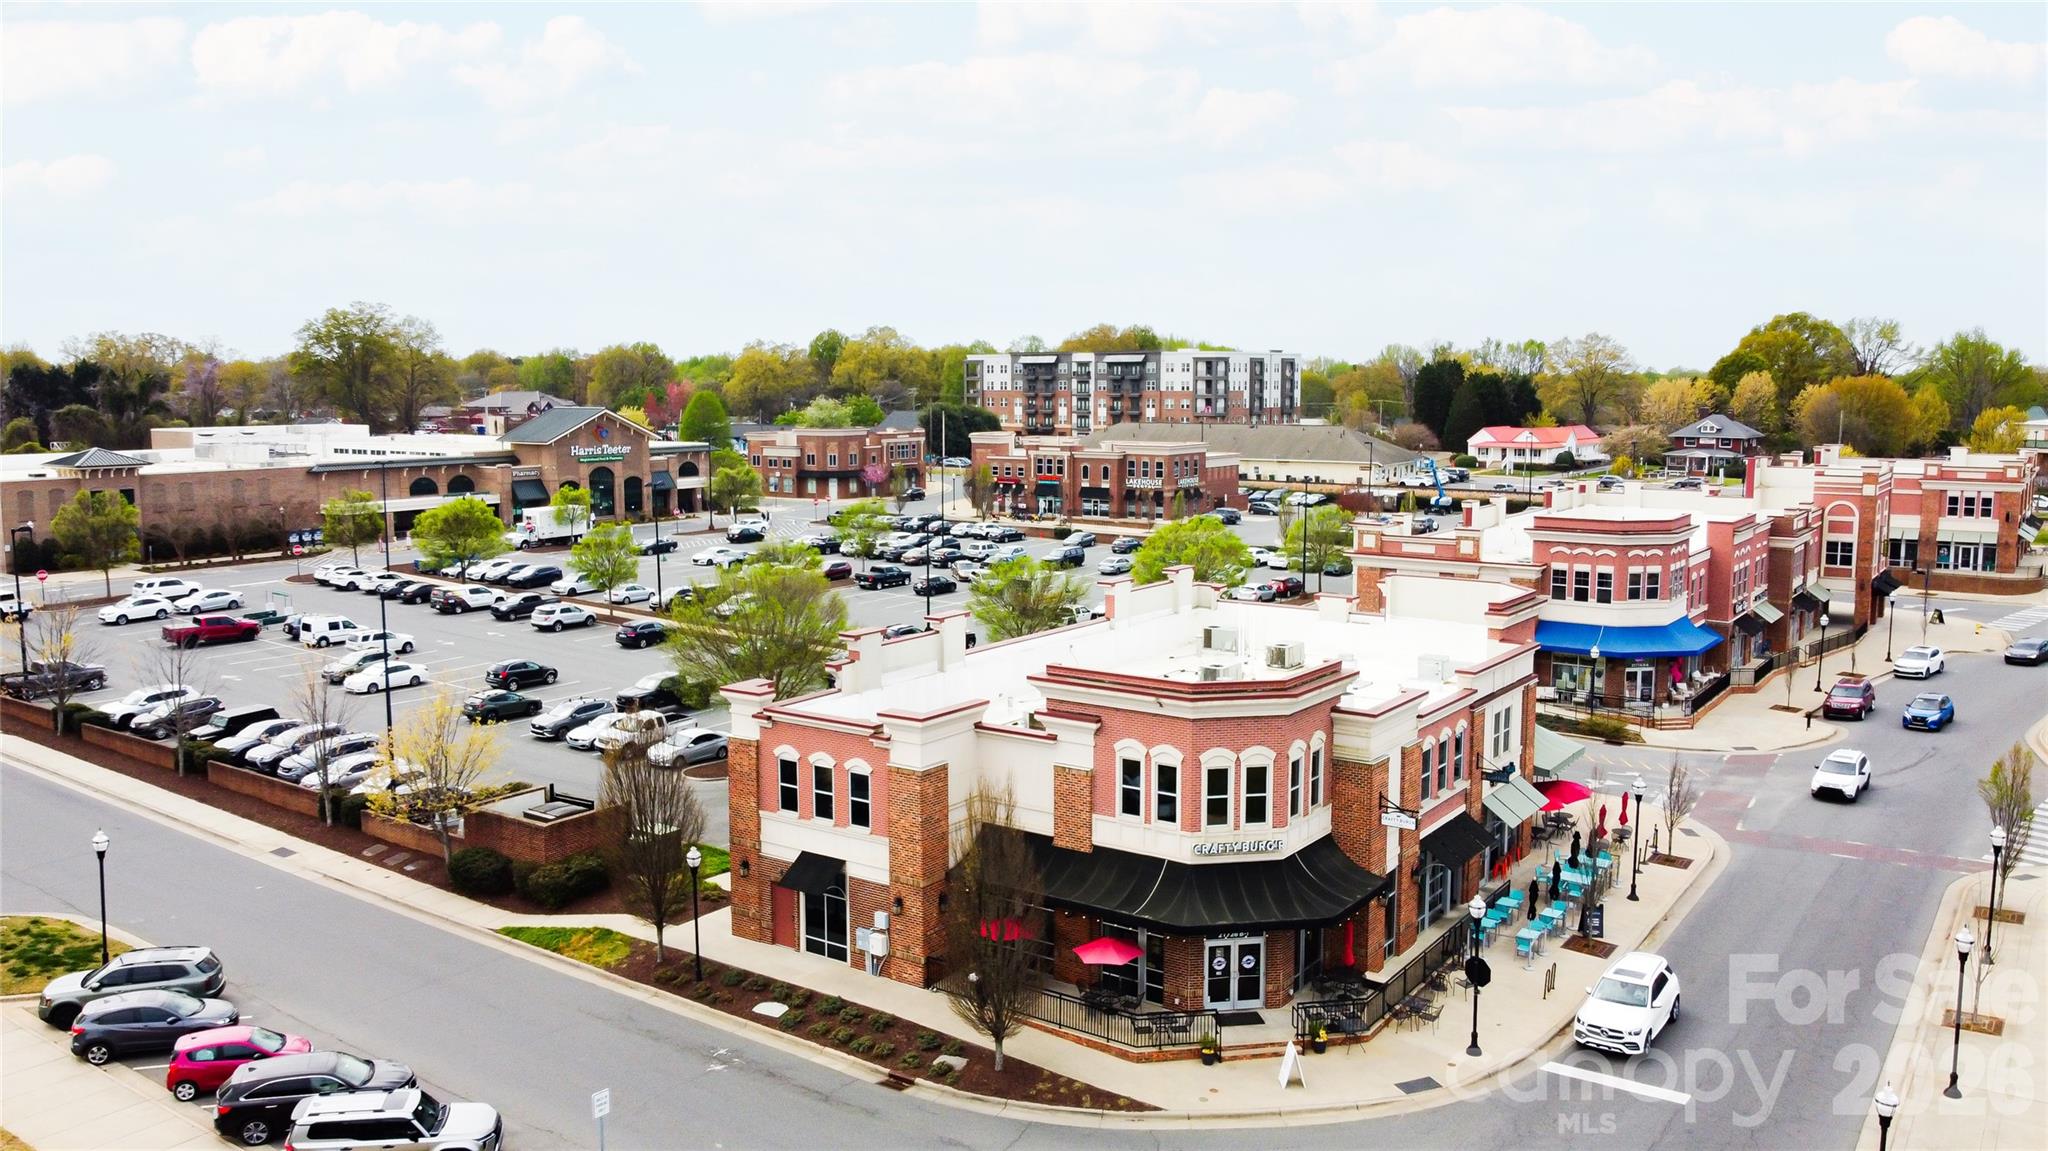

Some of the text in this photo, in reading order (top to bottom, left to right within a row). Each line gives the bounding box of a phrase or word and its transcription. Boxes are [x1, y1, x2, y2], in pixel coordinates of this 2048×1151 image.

[571, 444, 631, 456] Harris Teeter
[1125, 478, 1163, 486] LAKEHOUSE
[1193, 842, 1241, 855] CRAFTY
